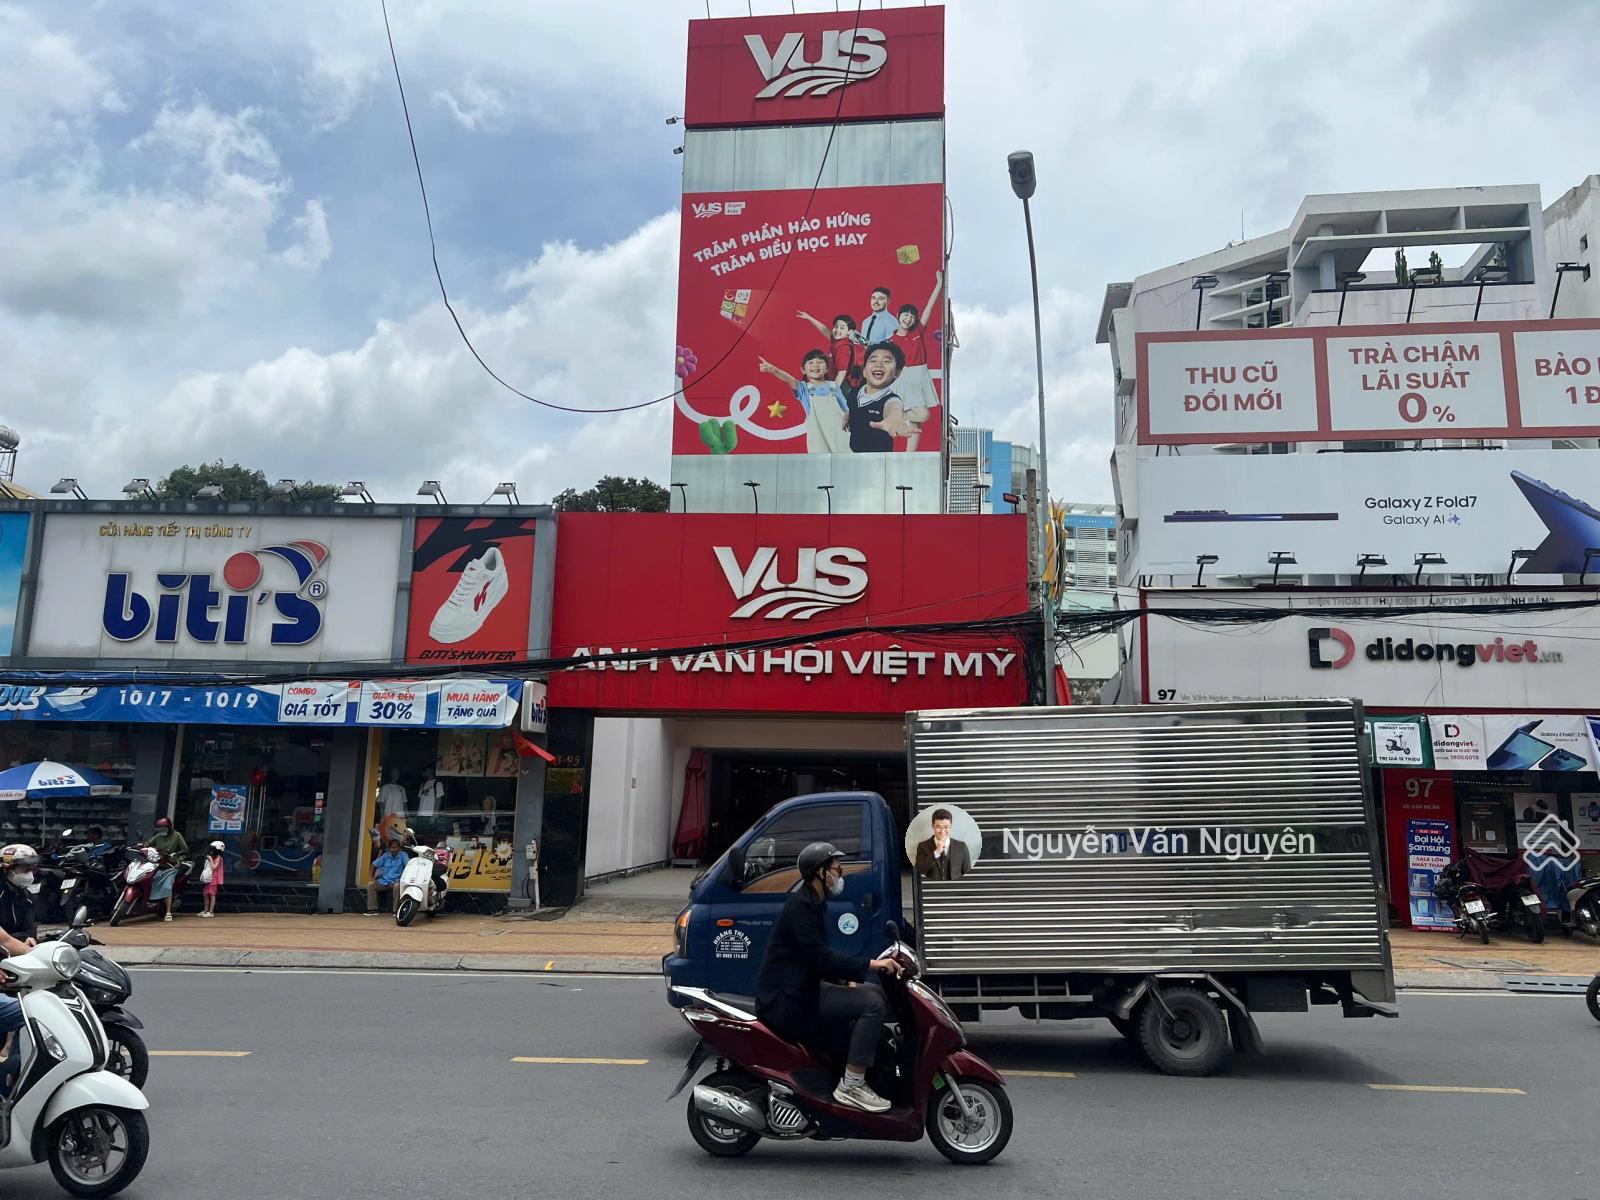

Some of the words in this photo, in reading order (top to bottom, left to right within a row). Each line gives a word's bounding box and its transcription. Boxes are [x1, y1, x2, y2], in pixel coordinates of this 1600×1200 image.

[744, 27, 888, 83] VUS
[691, 202, 722, 216] VUS
[693, 238, 738, 263] TRĂM
[741, 222, 784, 247] PHẦN
[826, 211, 871, 229] HỨNG
[711, 251, 756, 277] TRĂM
[759, 238, 792, 261] ĐIỀU
[798, 236, 829, 252] HỌC
[835, 233, 867, 246] HAY
[1349, 341, 1399, 365] TRẢ
[1403, 340, 1480, 366] CHẬM
[1185, 366, 1236, 384] THU
[1243, 360, 1278, 383] CŨ
[1535, 351, 1592, 377] BẢO
[1362, 369, 1400, 391] LÃI
[1406, 366, 1470, 389] SUẤT
[1184, 388, 1228, 412] ĐỔI
[1234, 387, 1282, 411] MỚI
[1566, 386, 1578, 405] 1
[1364, 497, 1421, 511] Galaxy
[1424, 497, 1433, 508] Z
[1436, 496, 1477, 508] Fold7
[124, 522, 153, 537] HÀNG
[157, 520, 180, 537] TIẾP
[185, 525, 200, 540] THỊ
[204, 525, 233, 538] CÔNG
[237, 527, 252, 538] TY
[1383, 514, 1430, 527] Galaxy
[1433, 515, 1445, 524] AI
[712, 546, 868, 602] VUS
[102, 550, 324, 646] biti's
[1429, 596, 1468, 606] LAPTOP
[456, 649, 516, 661] HUNTER
[1365, 637, 1564, 667] didongviet.vn
[763, 643, 833, 682] HỘI
[842, 643, 936, 683] VIỆT
[943, 647, 1017, 677] MỸ
[120, 689, 172, 706] 10/7
[205, 691, 259, 708] 10/9
[287, 687, 317, 696] COMBO
[446, 692, 470, 703] MUA
[473, 690, 500, 703] HÀNG
[1157, 689, 1177, 701] 97
[284, 701, 308, 717] GIÁ
[312, 694, 341, 717] TỐT
[369, 701, 413, 720] 30%
[446, 705, 475, 719] TẶNG
[475, 704, 498, 717] QUÀ
[1405, 778, 1434, 798] 97
[1409, 843, 1450, 854] Samsung
[1414, 835, 1428, 845] Đại
[1430, 835, 1445, 845] Hội
